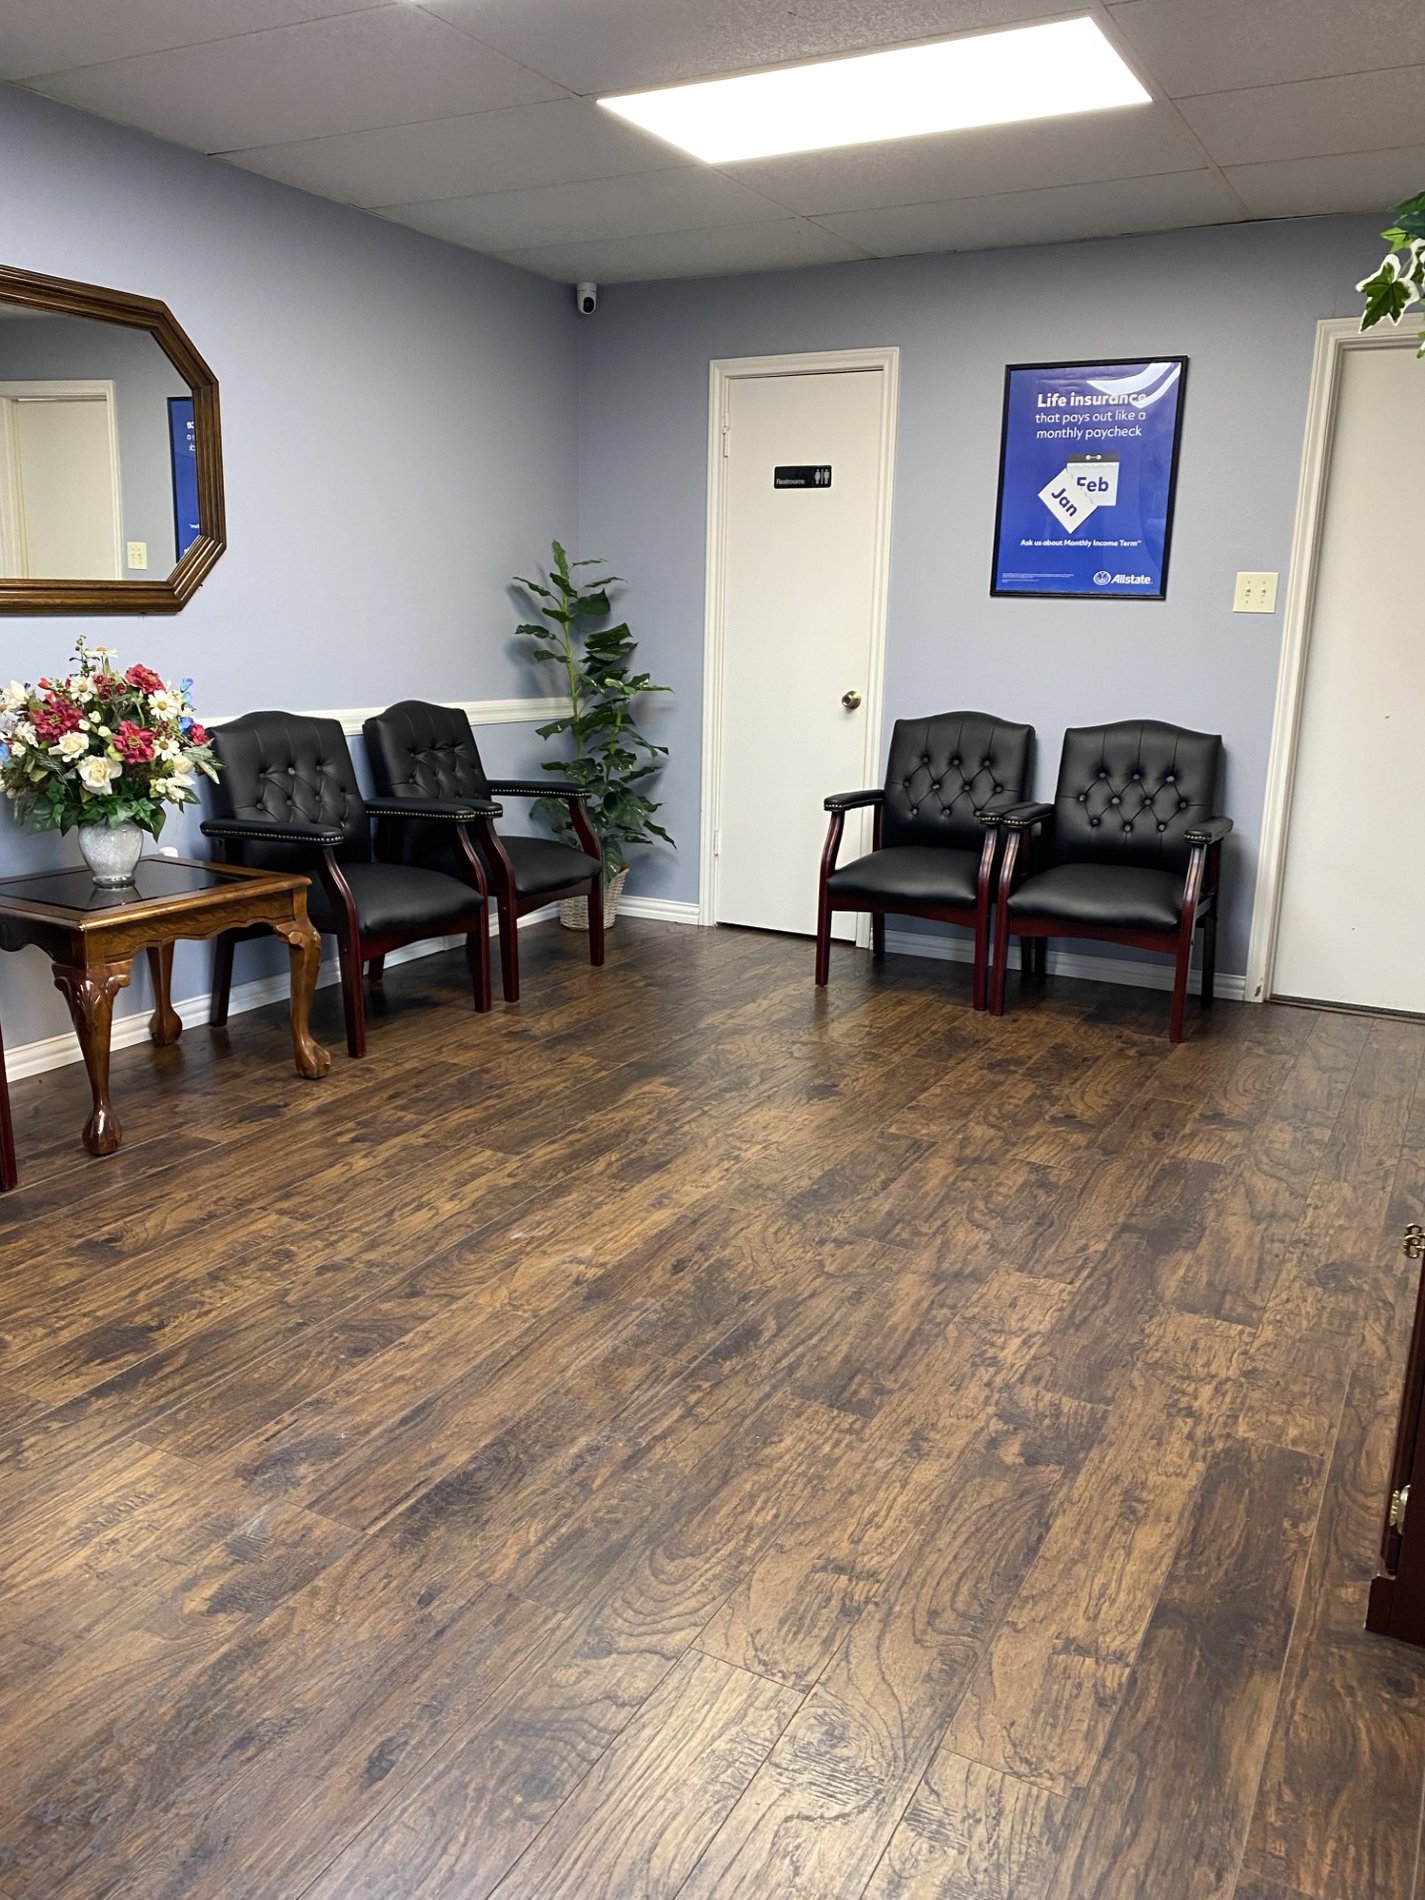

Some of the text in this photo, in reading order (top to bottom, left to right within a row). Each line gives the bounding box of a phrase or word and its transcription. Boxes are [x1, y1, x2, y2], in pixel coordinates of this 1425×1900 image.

[1037, 392, 1067, 407] Life
[1035, 409, 1146, 425] that pays out like a
[1036, 425, 1142, 440] monthly paycheck
[1077, 476, 1109, 492] Feb
[1051, 488, 1078, 517] Jan
[1063, 539, 1092, 548] Monthly
[1093, 539, 1119, 547] Income
[1110, 574, 1152, 585] Allstate
